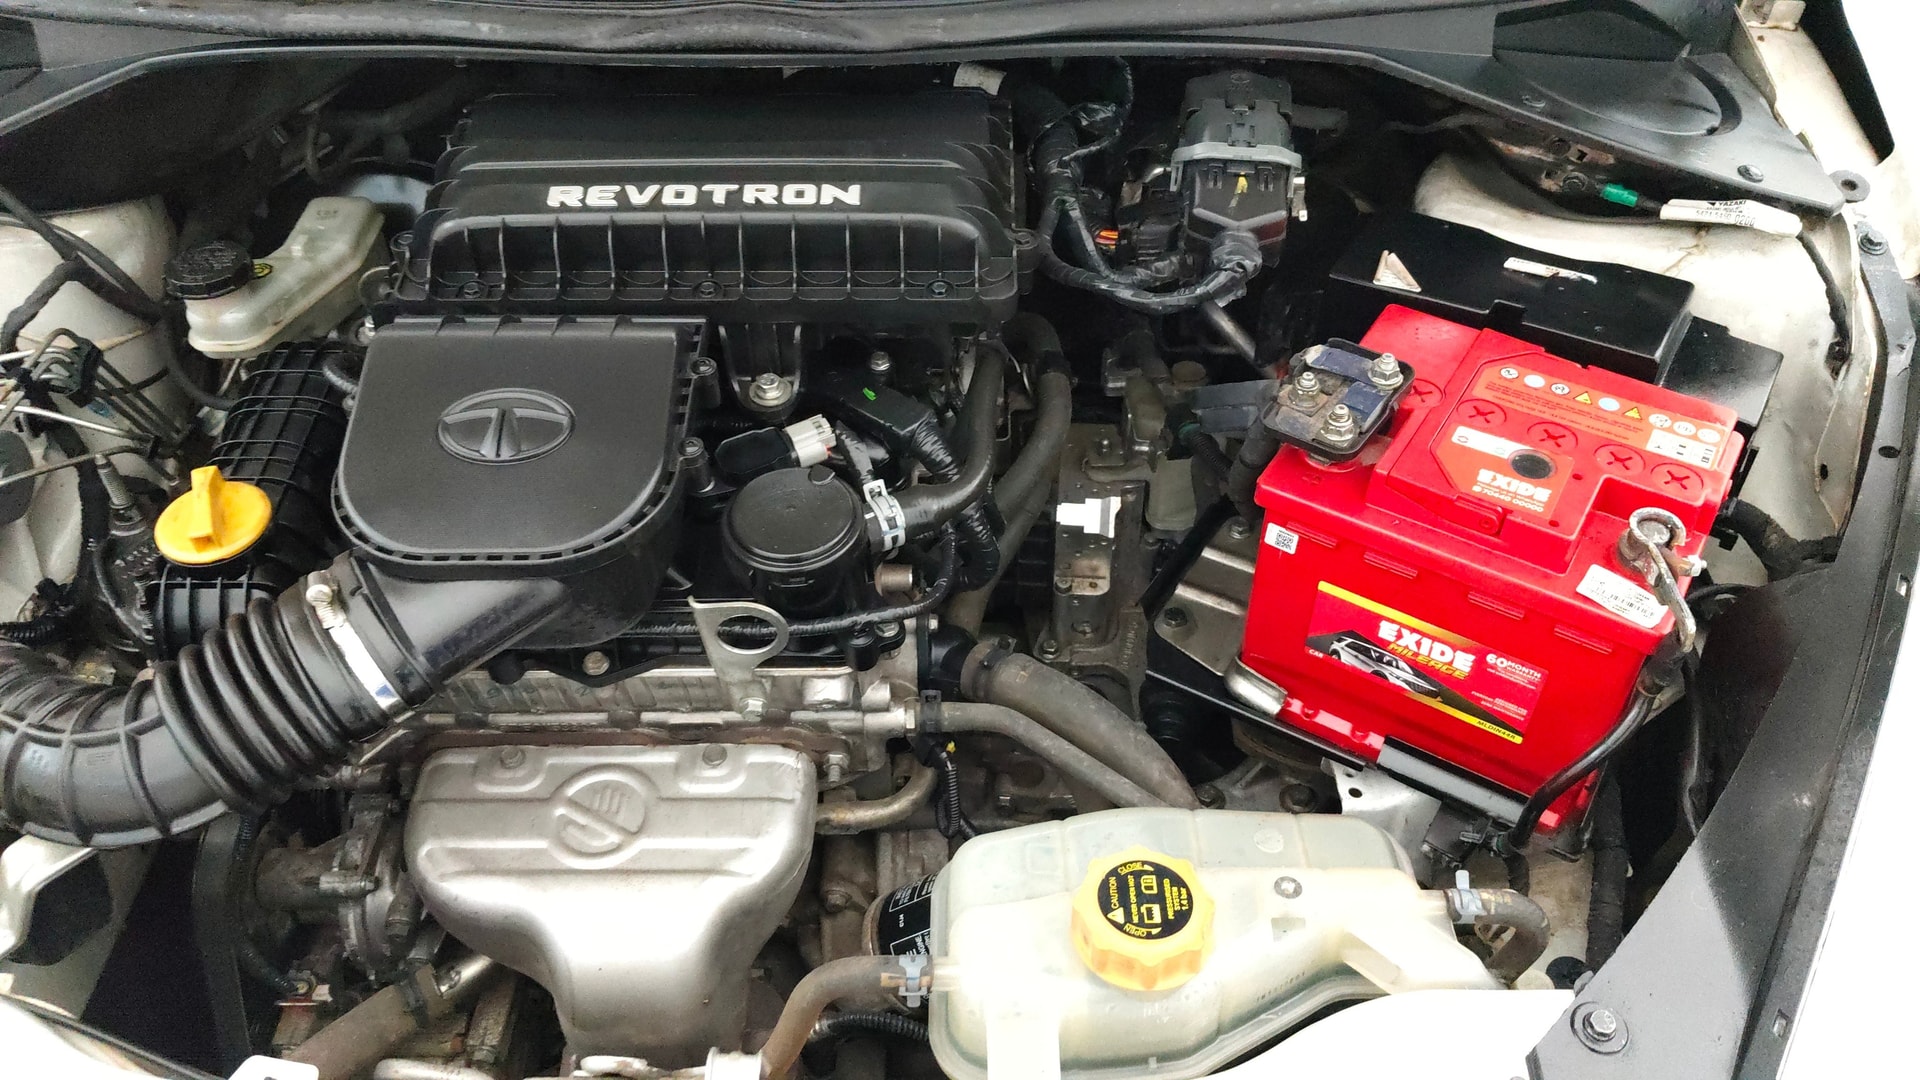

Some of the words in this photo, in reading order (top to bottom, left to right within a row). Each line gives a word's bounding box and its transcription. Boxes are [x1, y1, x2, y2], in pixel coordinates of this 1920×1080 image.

[546, 184, 861, 207] REVOTRON
[1477, 468, 1552, 502] EXIDE
[1309, 649, 1324, 659] CAR
[1378, 620, 1476, 673] EXIDE
[1387, 643, 1469, 680] MILEAGE
[1486, 653, 1508, 668] 60
[1507, 661, 1541, 679] MONTH
[1118, 862, 1143, 874] CLOSE
[1109, 877, 1119, 909] CAUTION
[1129, 887, 1137, 903] OPEN
[1171, 886, 1181, 911] SYSTEM
[1130, 904, 1139, 923] NEVER
[1123, 924, 1147, 937] OPEN
